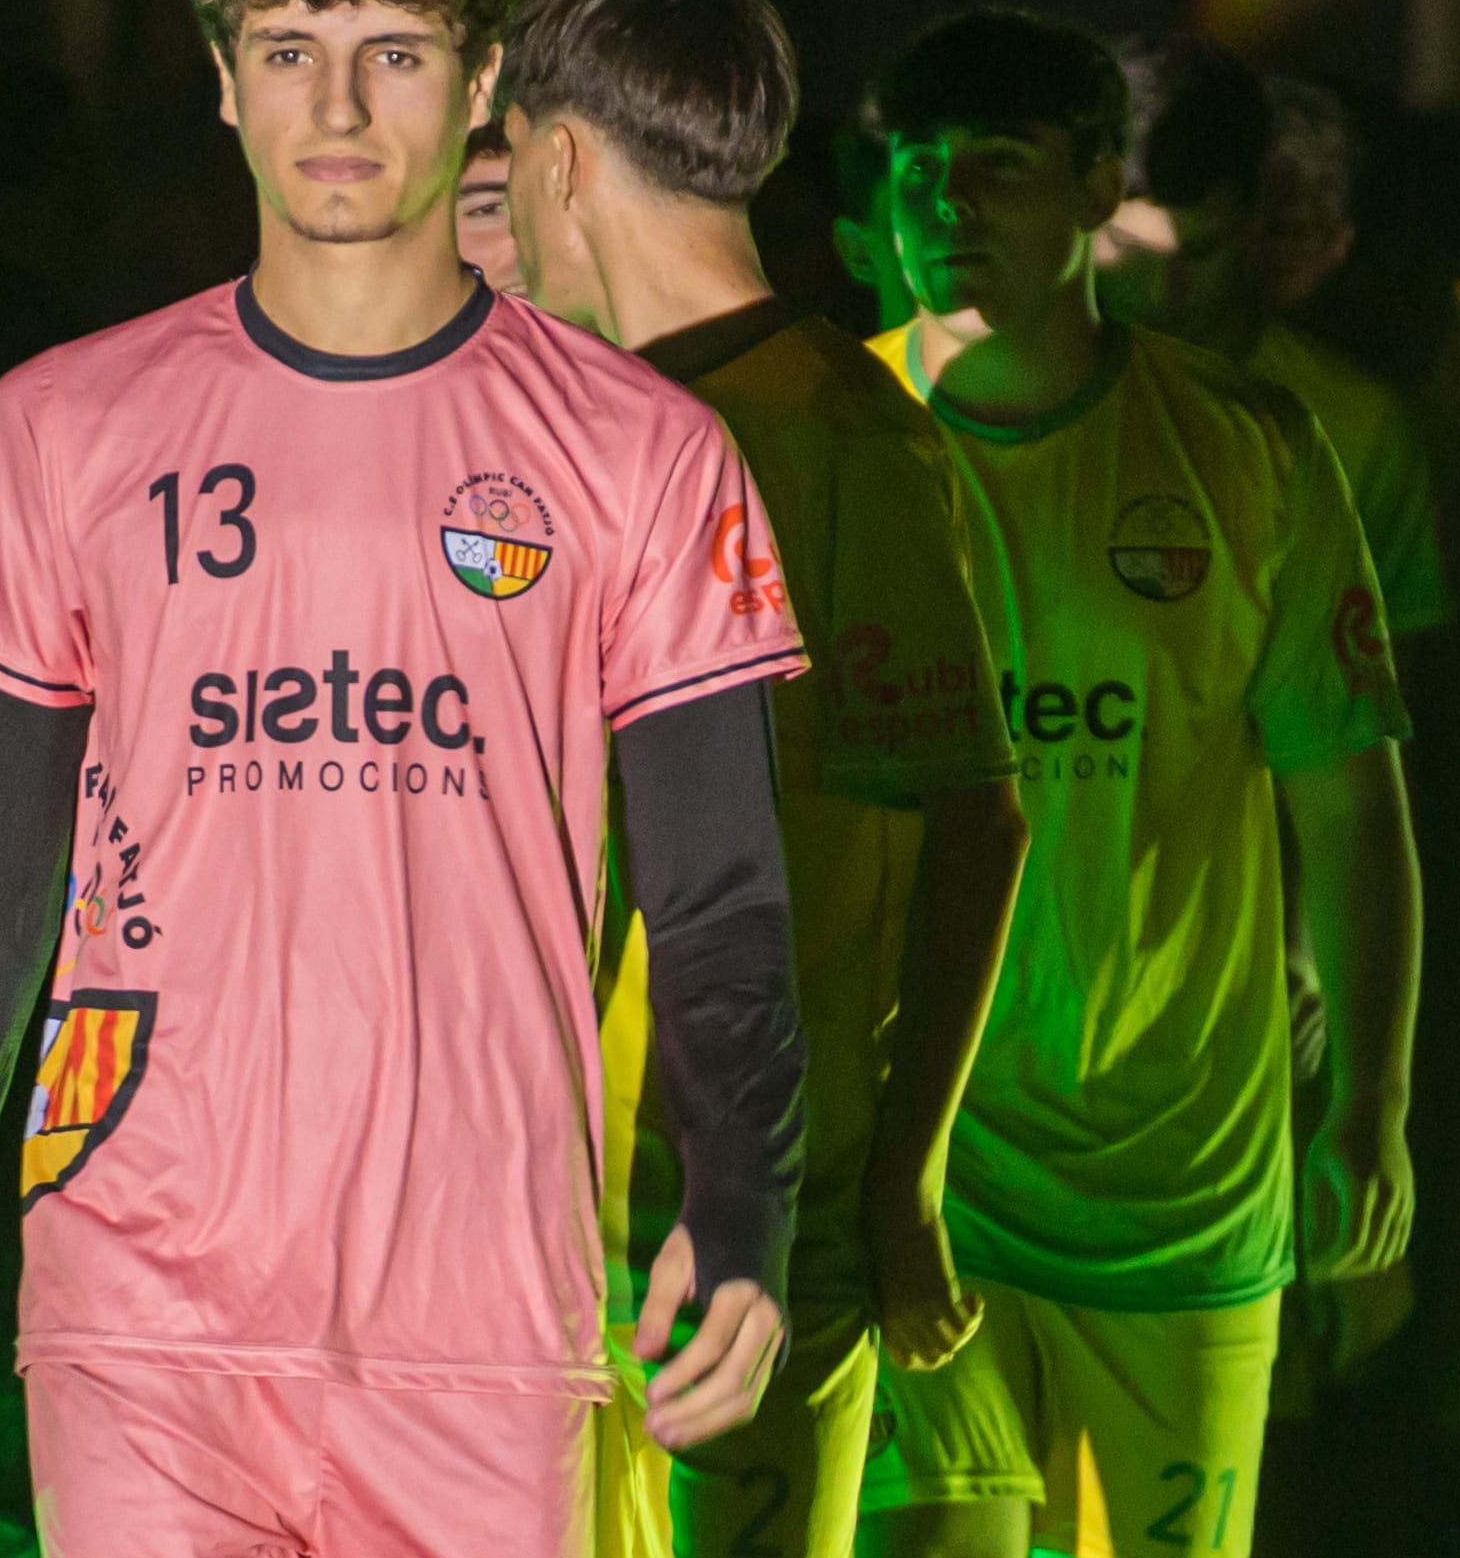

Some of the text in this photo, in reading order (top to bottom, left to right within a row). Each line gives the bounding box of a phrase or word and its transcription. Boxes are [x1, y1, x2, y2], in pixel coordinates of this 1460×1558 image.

[148, 463, 257, 586] 13
[729, 1464, 790, 1558] 2
[1145, 1461, 1236, 1550] 21
